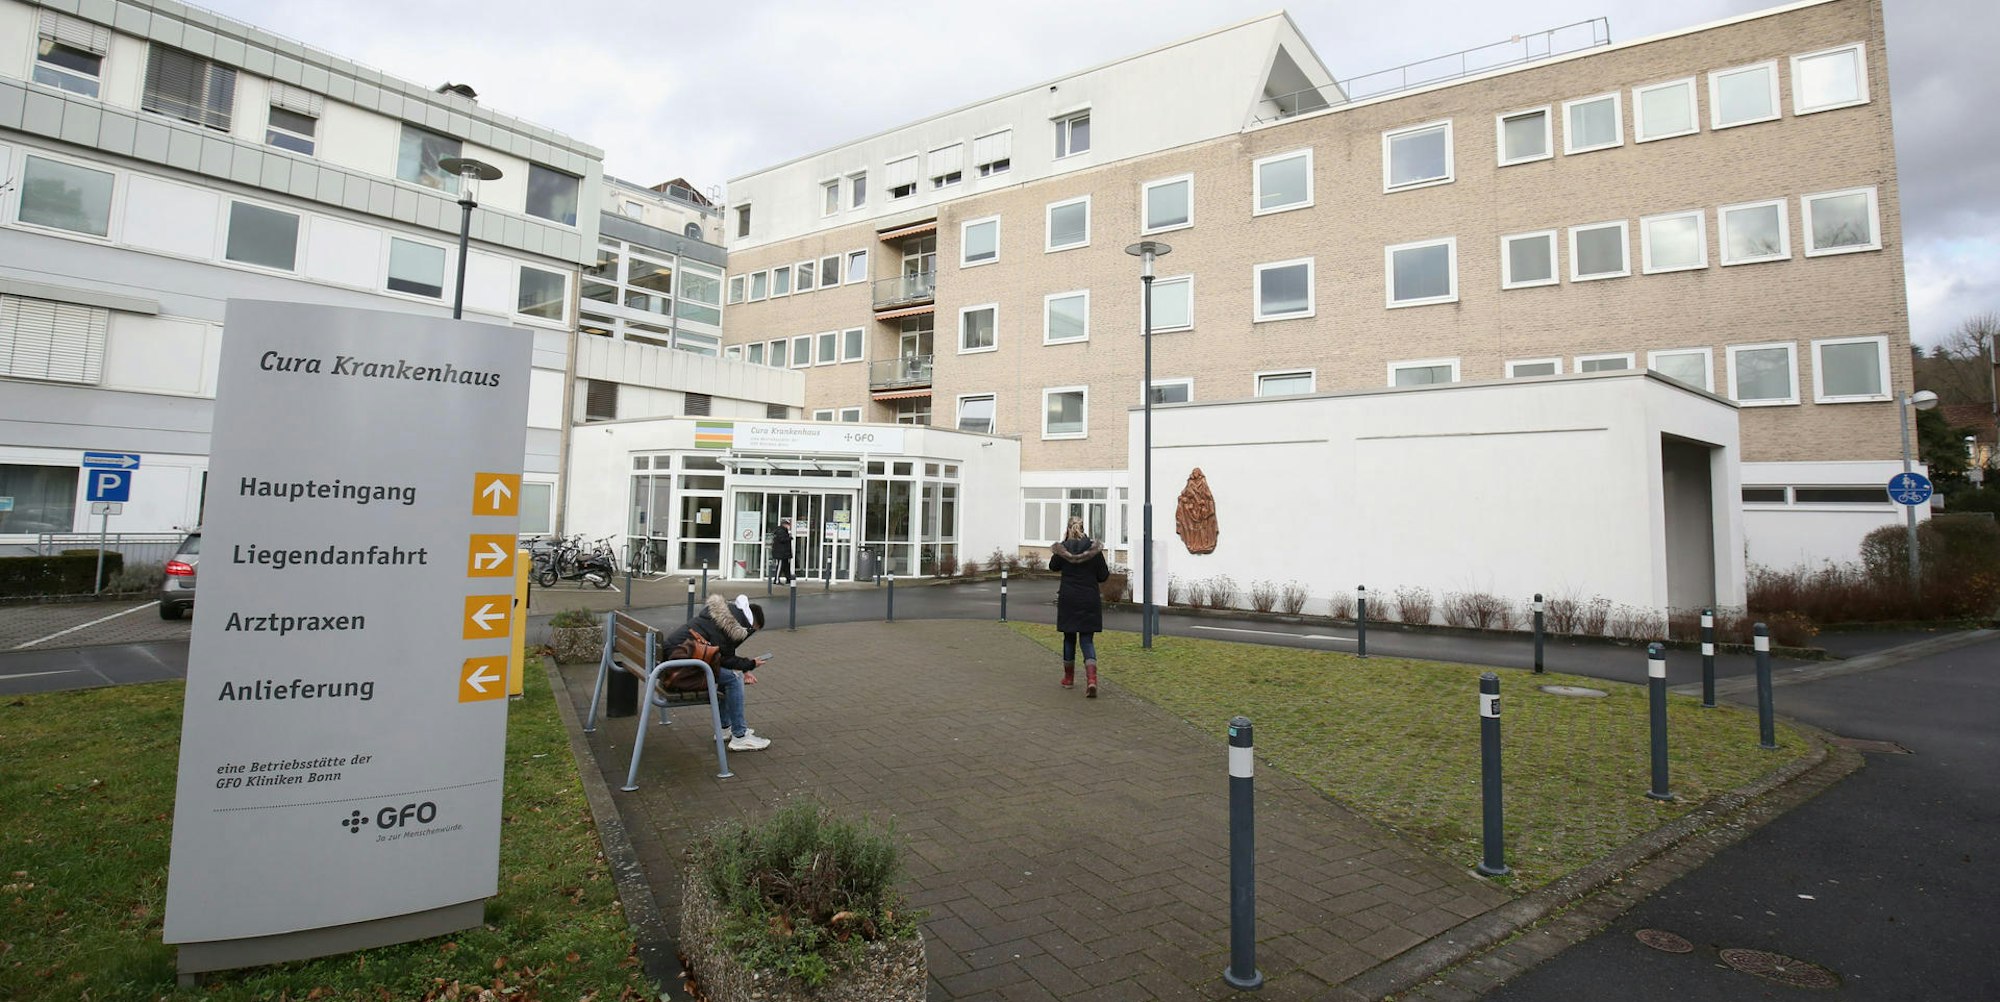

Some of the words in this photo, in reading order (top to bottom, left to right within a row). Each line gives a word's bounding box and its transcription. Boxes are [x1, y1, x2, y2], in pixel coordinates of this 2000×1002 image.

[259, 350, 322, 375] Cura
[330, 354, 502, 387] Krankenhaus
[751, 427, 769, 435] Cura
[771, 427, 821, 437] Krankenhaus
[854, 433, 874, 442] GFO
[96, 473, 122, 498] P
[239, 477, 417, 505] Haupteingang
[232, 544, 428, 570] Liegendanfahrt
[224, 611, 366, 636] Arztpraxen
[218, 679, 375, 703] Anlieferung
[216, 763, 246, 774] eine
[250, 756, 346, 773] Betriebsstätte
[350, 754, 373, 765] der
[216, 777, 242, 789] GFO
[246, 773, 303, 787] Kliniken
[307, 771, 342, 783] Bonn
[376, 801, 437, 829] GFO
[375, 834, 386, 843] Ja
[388, 833, 401, 841] zur
